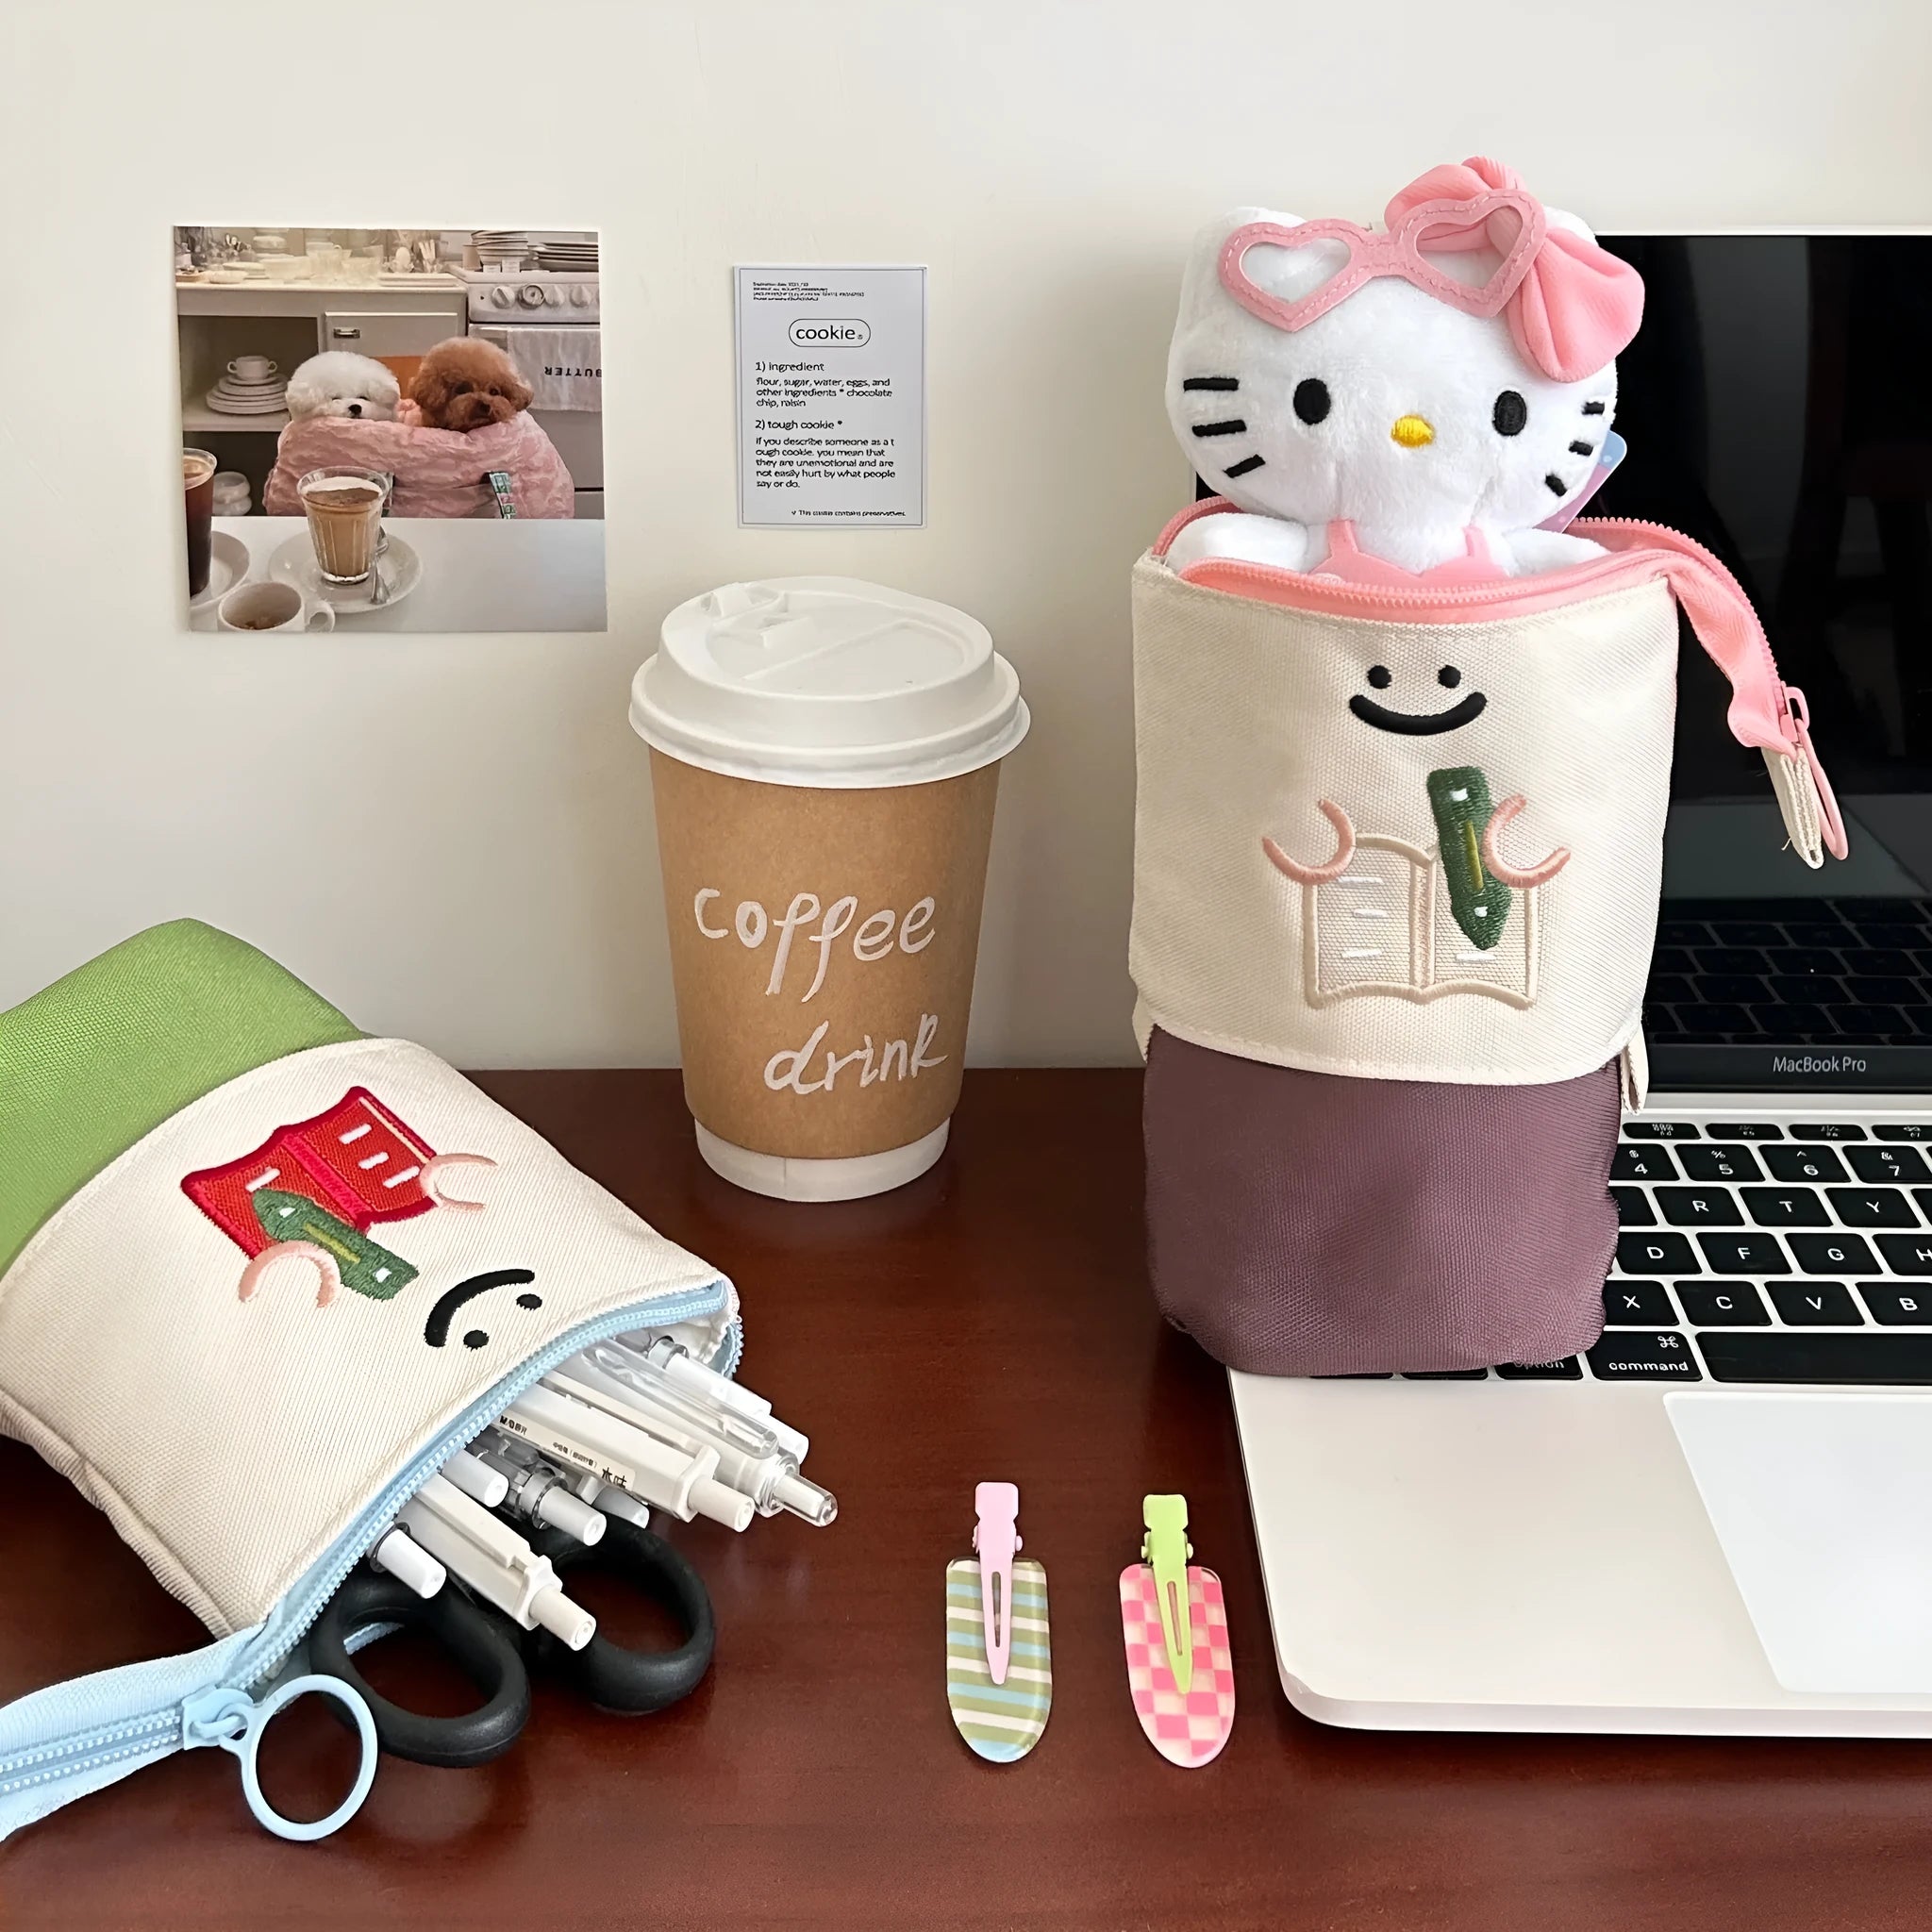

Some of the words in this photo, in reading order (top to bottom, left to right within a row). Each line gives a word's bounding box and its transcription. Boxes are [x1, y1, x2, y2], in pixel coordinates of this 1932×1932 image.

[544, 366, 602, 377] BUTTER
[756, 362, 765, 373] 1)
[769, 362, 824, 373] ingredient
[757, 377, 781, 387] flour,
[785, 389, 837, 398] ingredients
[846, 389, 892, 397] chocolate
[757, 399, 778, 408] chip,
[756, 420, 765, 430] 2)
[768, 420, 798, 430] tough
[801, 420, 834, 429] cookie
[756, 449, 780, 458] ough
[756, 459, 777, 468] they
[824, 470, 835, 478] by
[863, 471, 895, 479] people
[1773, 1056, 1839, 1073] MacBook
[1842, 1056, 1867, 1073] Pro
[1634, 1163, 1648, 1174] 4
[1718, 1163, 1734, 1175] 5
[1803, 1164, 1819, 1176] 6
[1888, 1165, 1901, 1177] 7
[1691, 1200, 1709, 1212] R
[1778, 1200, 1793, 1213] T
[1865, 1201, 1880, 1213] Y
[1646, 1246, 1665, 1259] D
[1737, 1247, 1751, 1260] F
[1827, 1247, 1845, 1261] G
[1623, 1295, 1641, 1309] X
[1715, 1296, 1733, 1309] C
[1805, 1296, 1822, 1310] V
[1898, 1297, 1918, 1311] B
[1608, 1360, 1689, 1372] command
